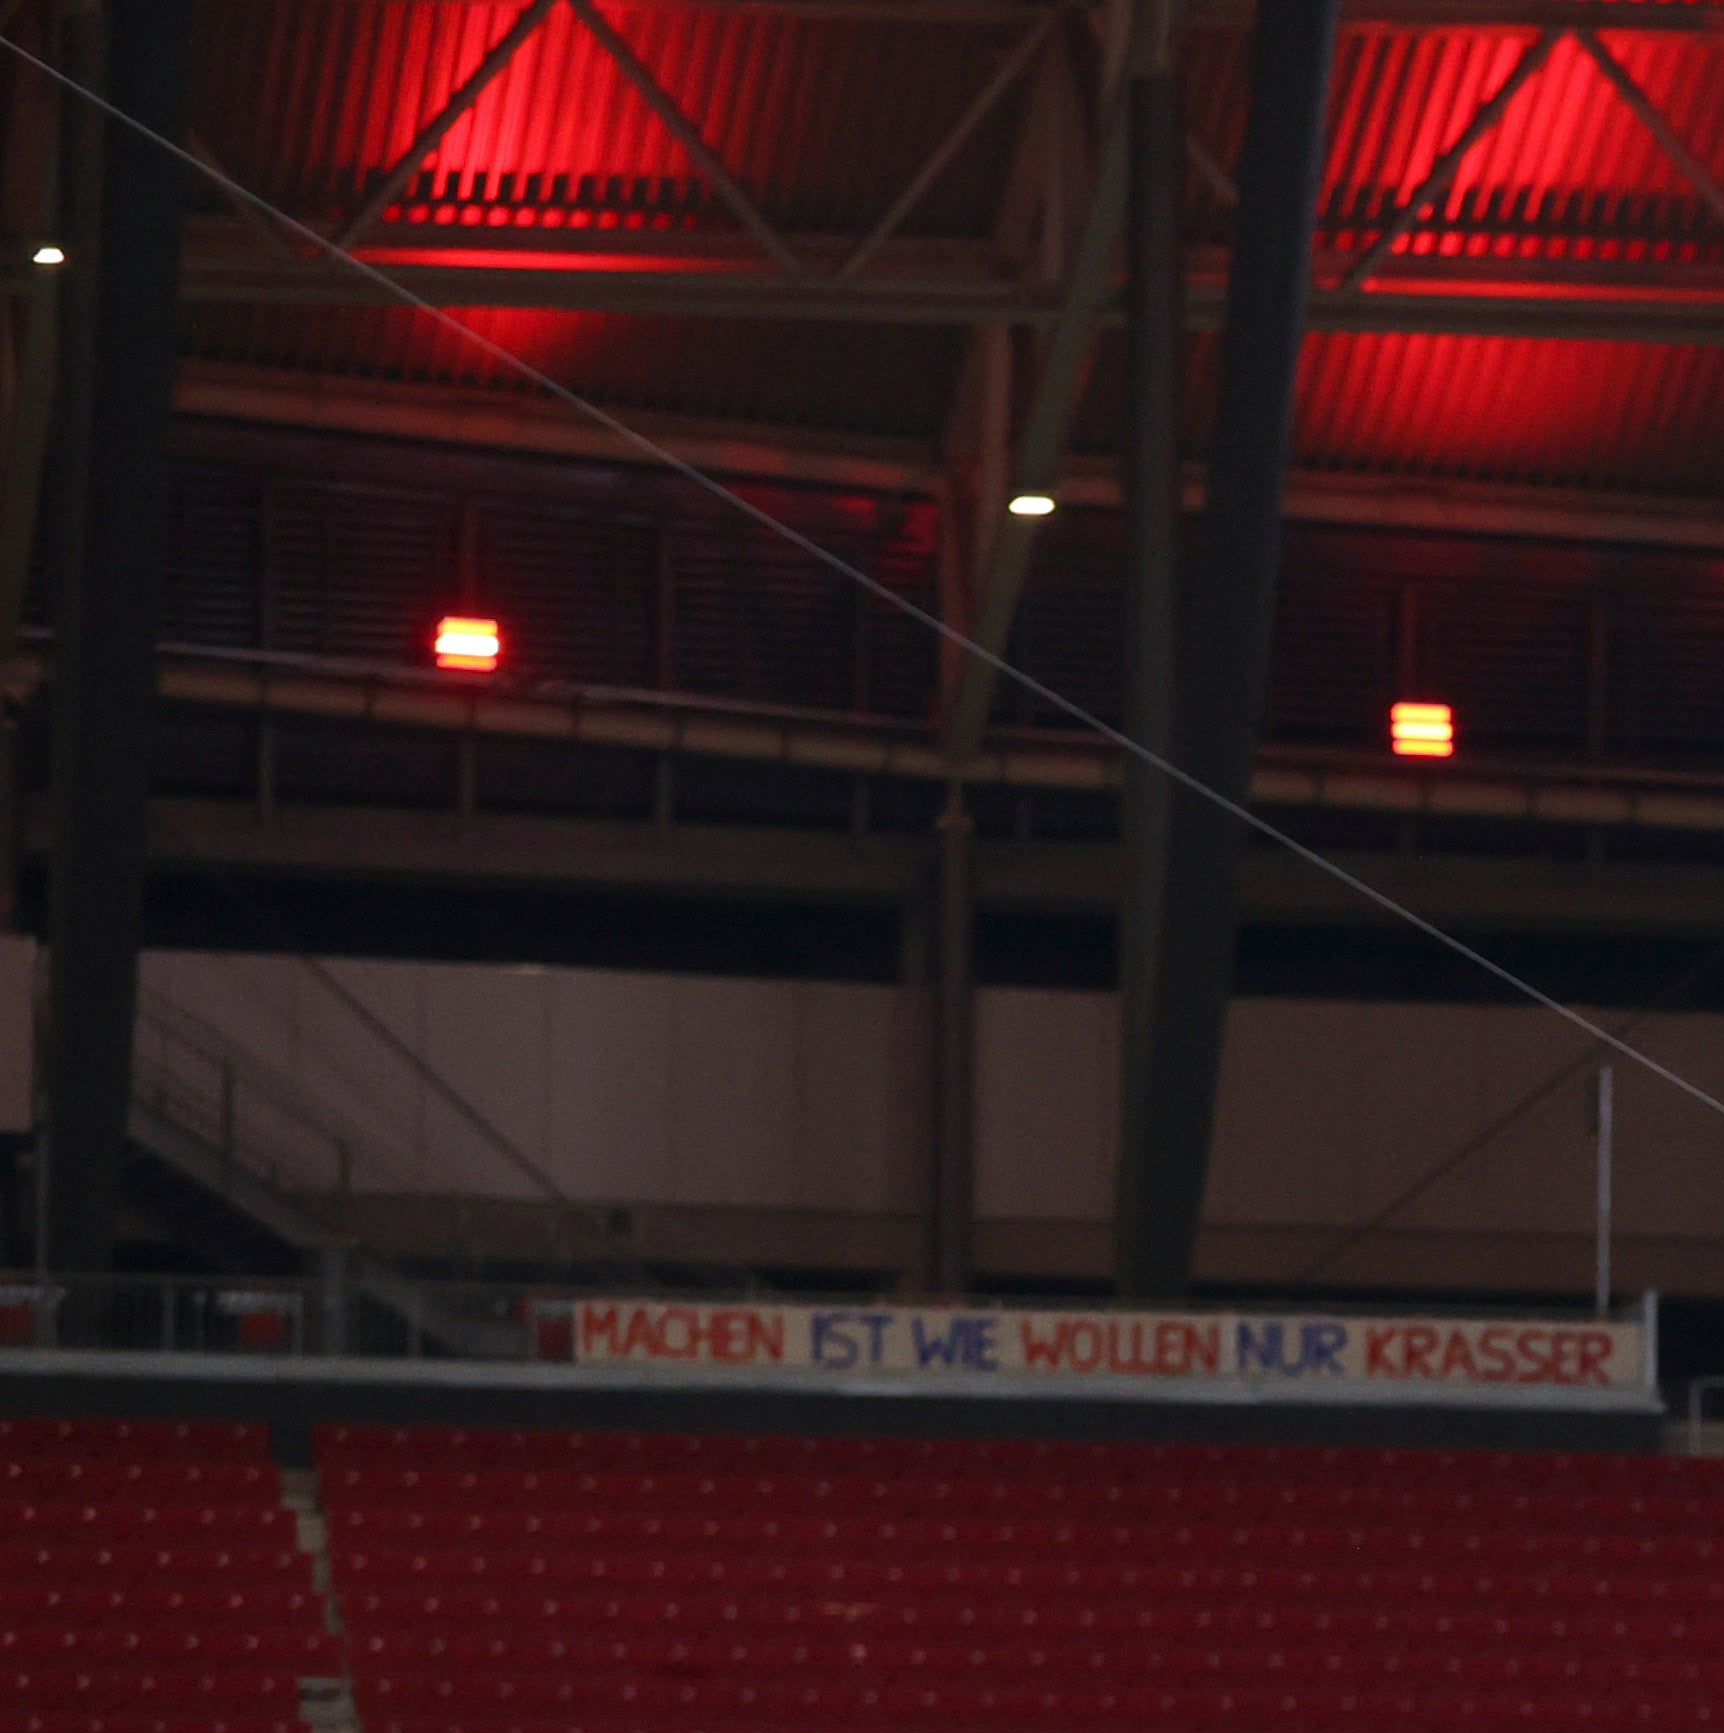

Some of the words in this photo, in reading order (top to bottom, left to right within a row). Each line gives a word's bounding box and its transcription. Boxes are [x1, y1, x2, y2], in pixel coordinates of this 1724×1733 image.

[582, 1303, 785, 1364] MACHEN
[810, 1310, 895, 1370] IST
[911, 1315, 999, 1371] WIE
[1018, 1317, 1220, 1376] WOLLEN
[1236, 1320, 1348, 1377] NUR
[1364, 1325, 1613, 1386] KRASSER
